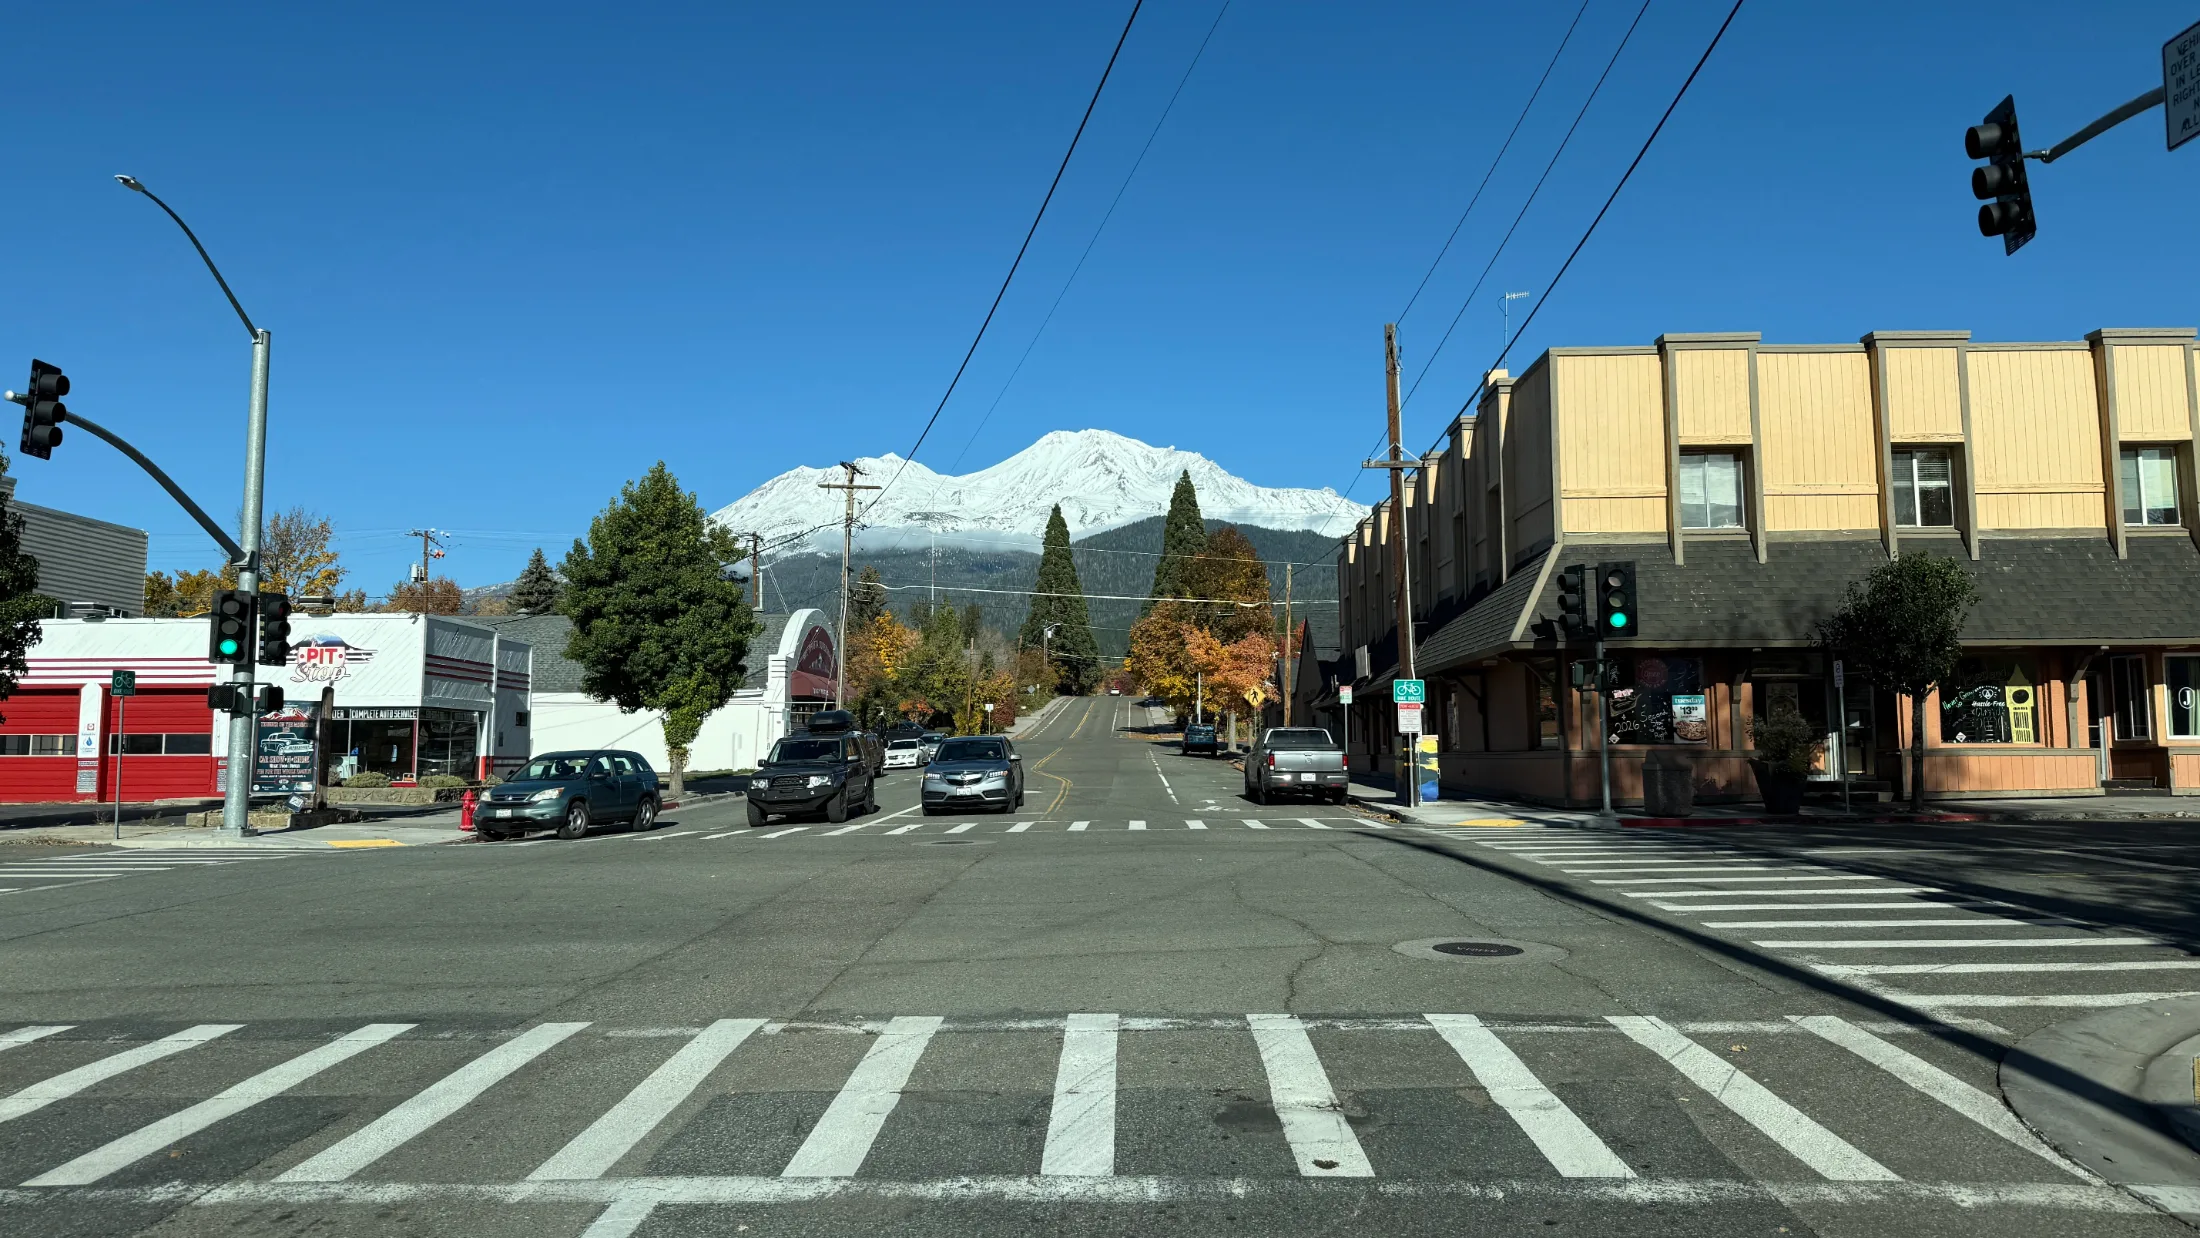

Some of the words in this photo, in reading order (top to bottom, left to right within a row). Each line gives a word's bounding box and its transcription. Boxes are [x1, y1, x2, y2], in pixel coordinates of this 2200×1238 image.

[2170, 51, 2196, 76] OVER
[2176, 74, 2185, 89] IN
[307, 648, 337, 664] PIT
[290, 662, 351, 686] Stop
[2182, 689, 2191, 706] J
[351, 709, 379, 719] COMPLETE
[379, 709, 394, 719] AUTO
[393, 709, 417, 719] SERVICE
[1614, 720, 1640, 733] 2026
